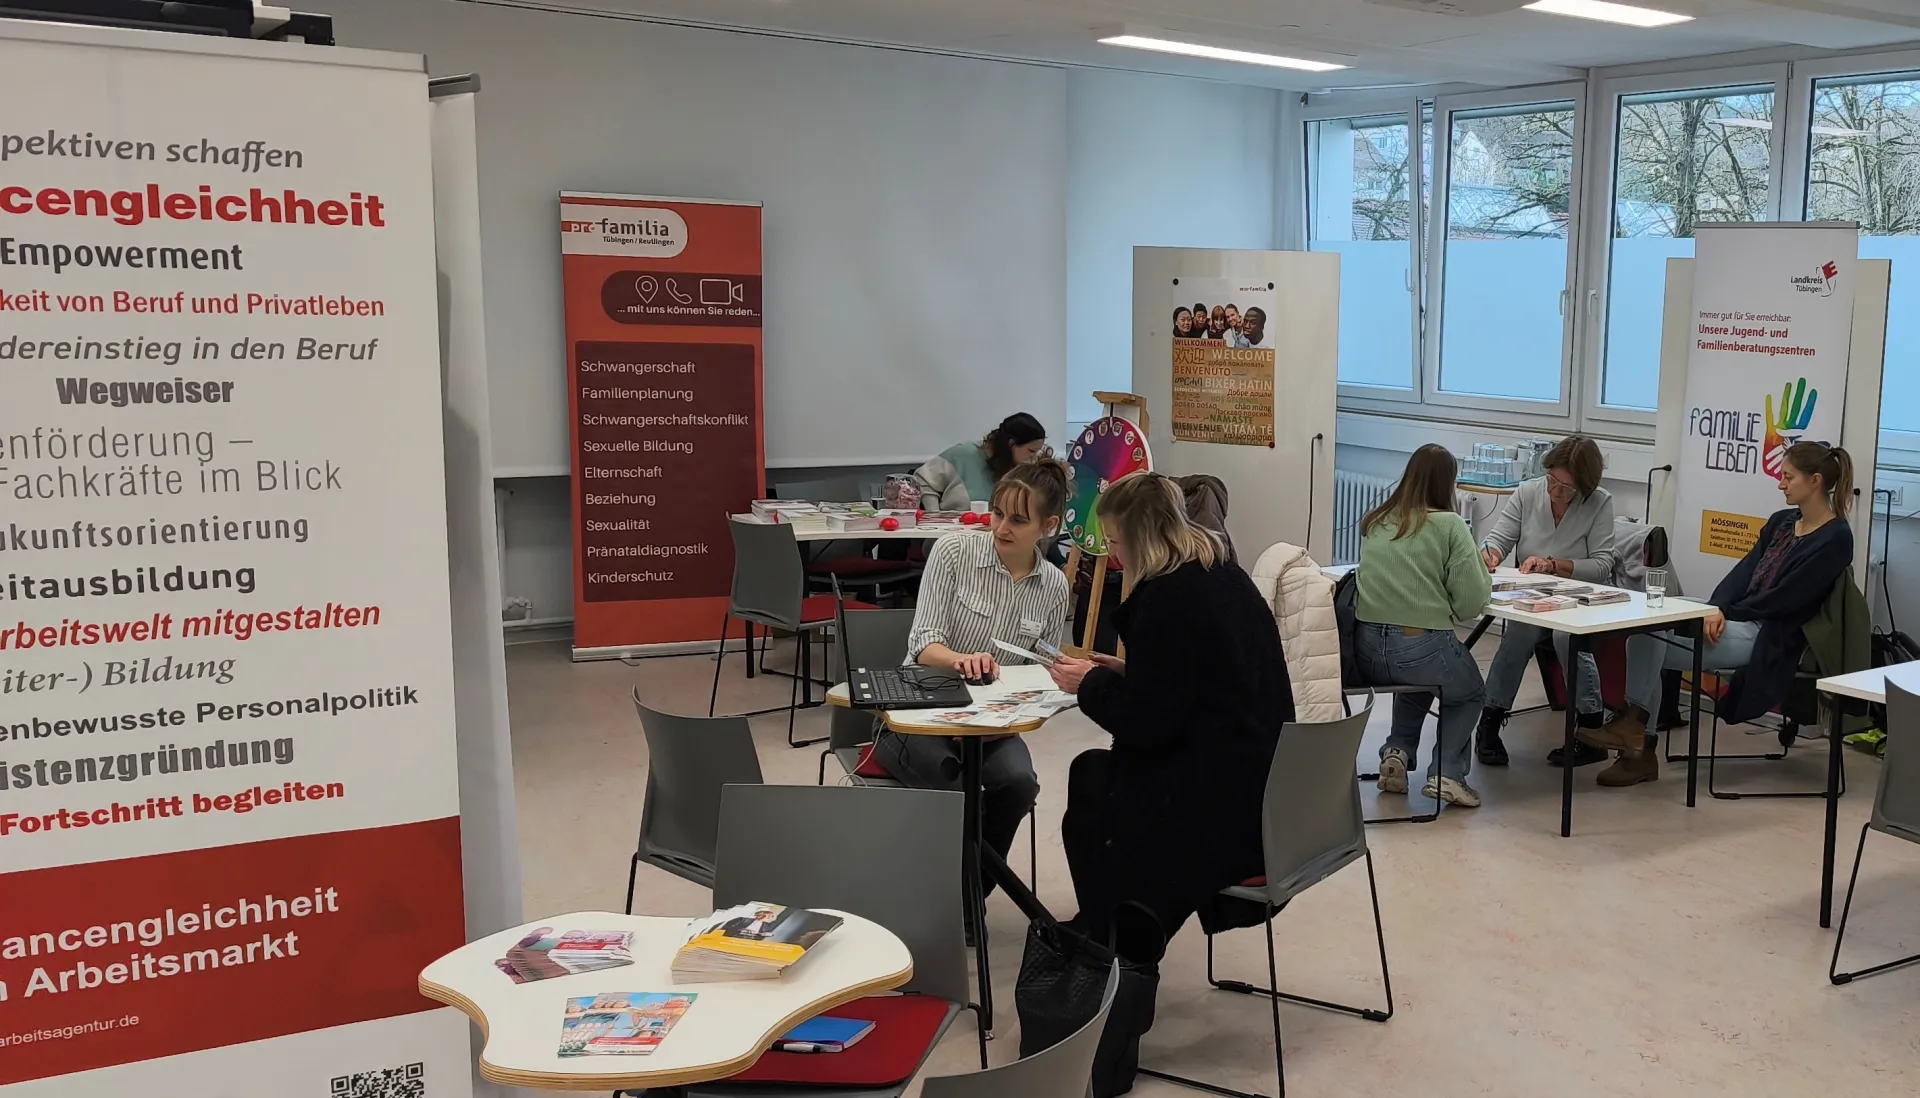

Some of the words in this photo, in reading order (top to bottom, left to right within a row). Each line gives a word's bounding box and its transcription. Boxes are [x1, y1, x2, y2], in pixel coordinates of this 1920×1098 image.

[167, 139, 303, 173] schaffen
[600, 218, 669, 237] familia
[603, 236, 634, 246] Tübingen
[639, 238, 675, 247] Reutlingen
[1, 237, 243, 274] Empowerment
[1790, 275, 1823, 285] Landkreis
[1796, 284, 1823, 294] Tübingen
[57, 294, 104, 313] von
[114, 291, 184, 314] Beruf
[192, 293, 239, 315] und
[247, 293, 385, 317] Privatleben
[627, 305, 645, 313] mit
[646, 306, 666, 314] uns
[667, 305, 706, 315] können
[707, 306, 723, 316] Sie
[1699, 310, 1720, 320] Immer
[1721, 312, 1733, 322] gut
[1733, 311, 1744, 320] für
[1745, 312, 1755, 321] Sie
[1698, 324, 1729, 336] Unsere
[1730, 325, 1768, 339] Jugend-
[1770, 328, 1789, 339] und
[193, 336, 220, 360] in
[230, 337, 285, 360] den
[296, 337, 378, 361] Beruf
[1212, 348, 1273, 362] WELCOME
[1697, 339, 1816, 357] Familienberatungszentren
[581, 361, 696, 375] Schwangerschaft
[1174, 366, 1231, 377] BENVENUTO
[1205, 377, 1236, 389] BIXER
[1239, 379, 1273, 391] HATIN
[56, 377, 235, 407] Wegweiser
[582, 387, 694, 402] Familienplanung
[582, 413, 748, 428] Schwangerschaftskonflikt
[583, 440, 640, 452] Sexuelle
[643, 440, 694, 454] Bildung
[200, 462, 240, 494] im
[257, 459, 343, 492] Blick
[584, 466, 663, 479] Elternschaft
[585, 493, 656, 506] Beziehung
[586, 519, 651, 531] Sexualität
[1711, 518, 1749, 530] MÖSSINGEN
[587, 543, 709, 558] Pränataldiagnostik
[0, 564, 256, 601] itausbildung
[588, 571, 674, 584] Kinderschutz
[182, 602, 381, 641] mitgestalten
[102, 655, 237, 687] Bildung
[197, 685, 419, 723] Personalpolitik
[0, 797, 183, 836] Fortschritt
[193, 781, 344, 813] begleiten
[24, 930, 300, 998] Arbeitsmarkt
